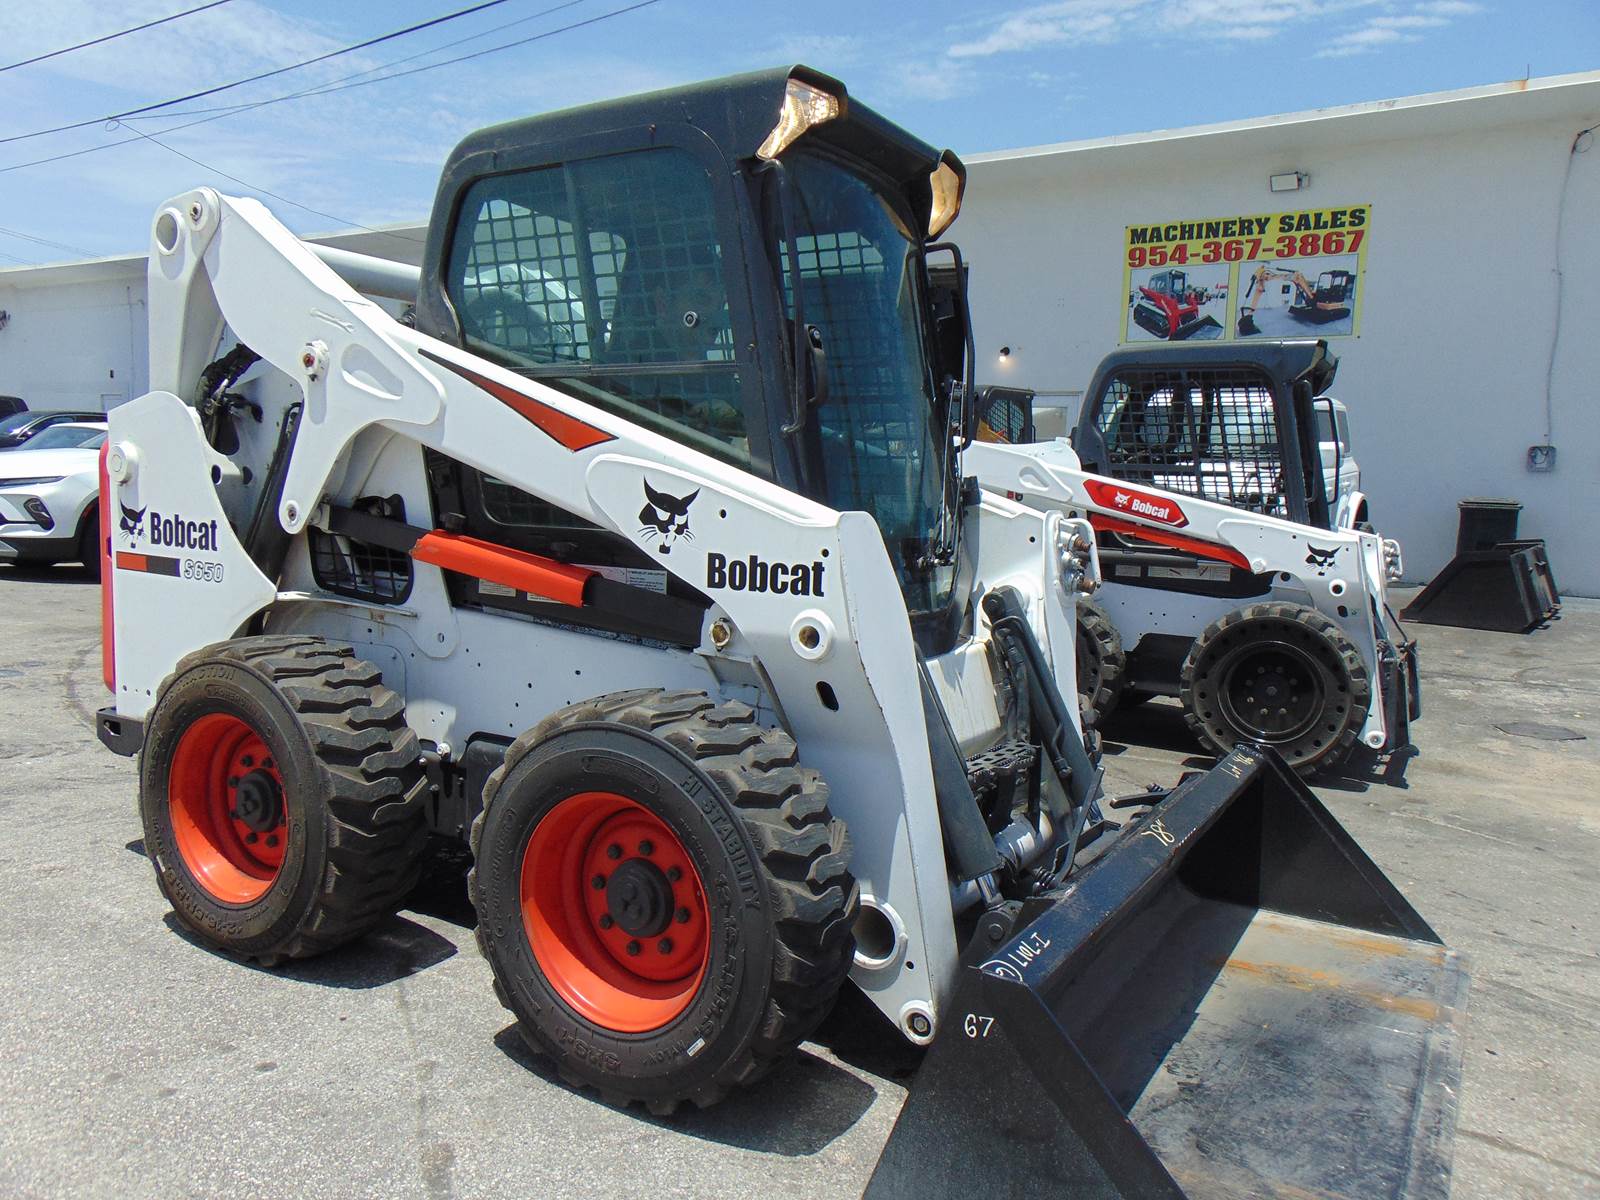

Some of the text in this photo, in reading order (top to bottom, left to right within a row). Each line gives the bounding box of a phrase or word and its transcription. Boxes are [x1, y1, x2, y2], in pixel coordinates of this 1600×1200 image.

[1130, 208, 1366, 245] MACHINERY SALES
[1128, 230, 1366, 268] 954-367-3867
[1131, 498, 1170, 520] Bobcat
[150, 511, 218, 552] Bobcat
[183, 558, 225, 583] S650
[706, 551, 826, 598] Bobcat
[964, 1013, 995, 1038] 67
